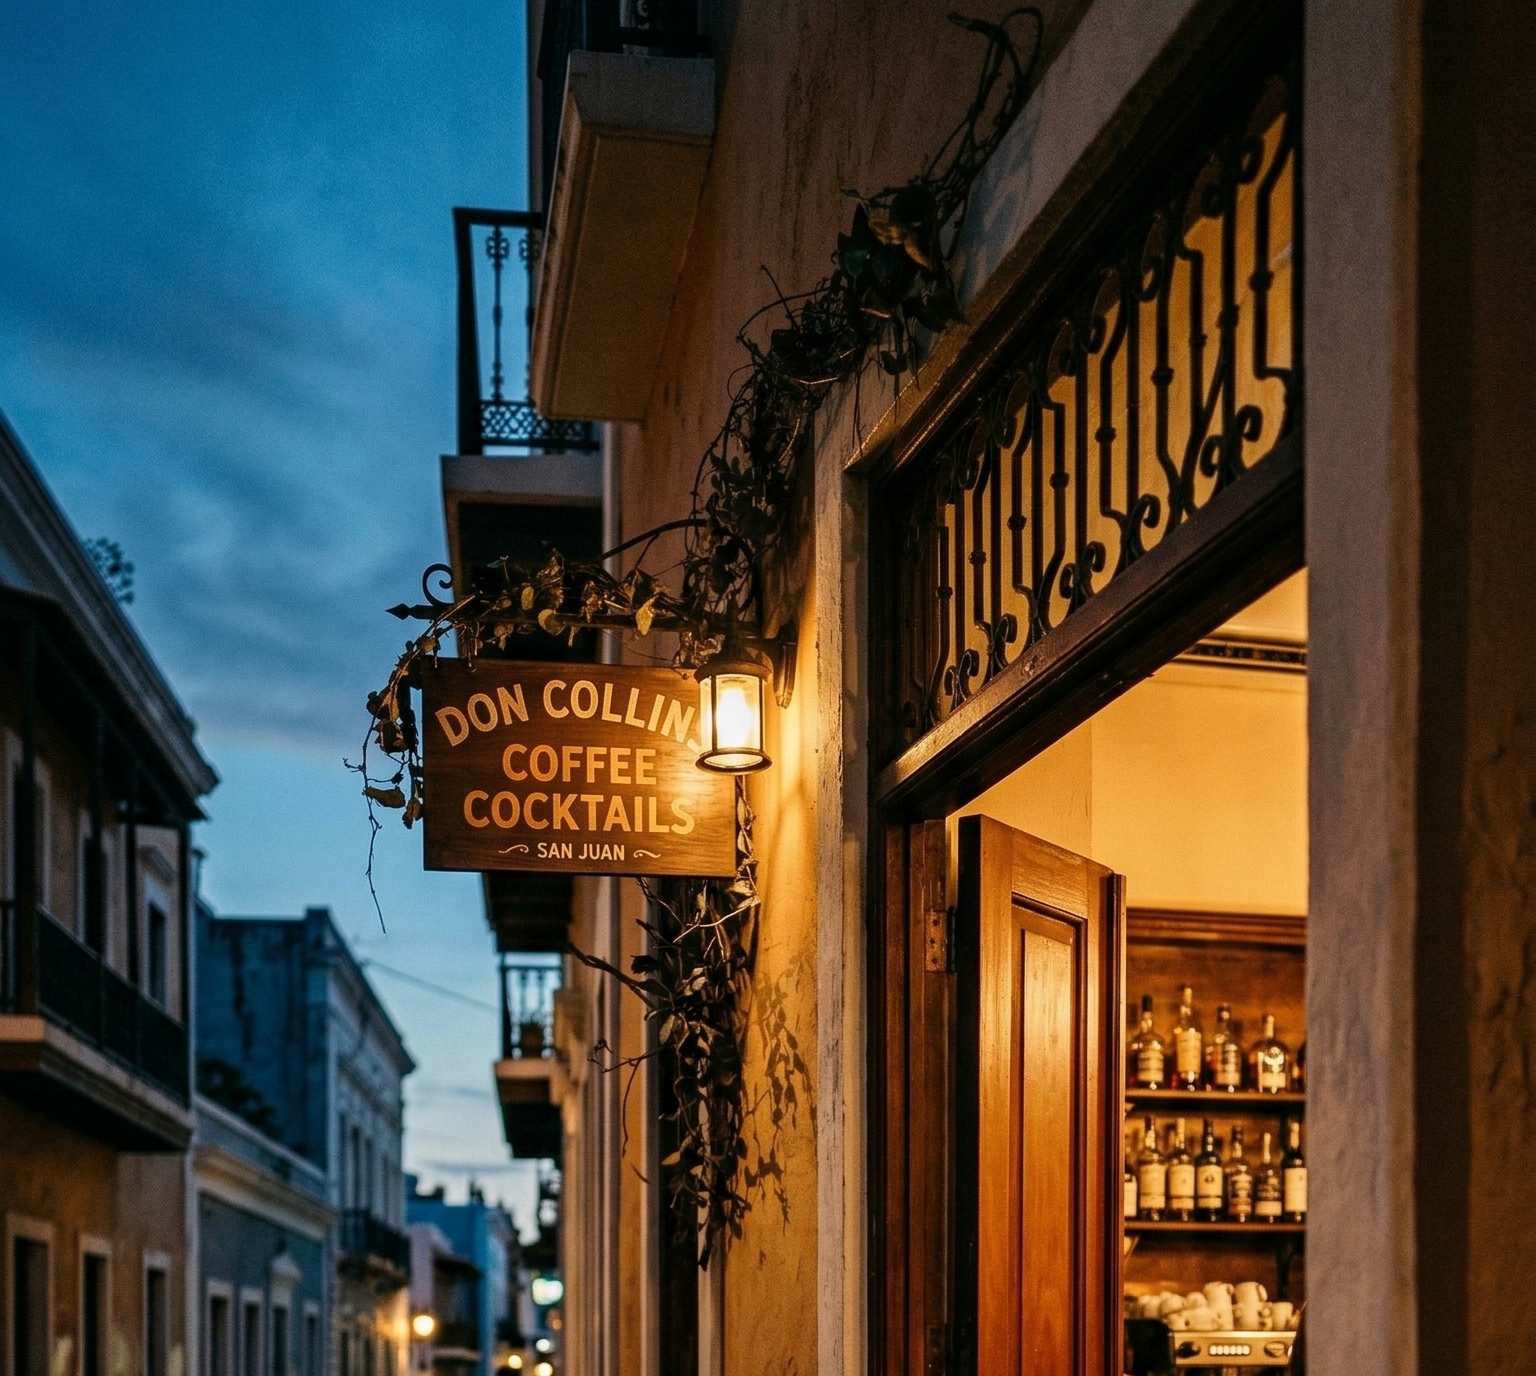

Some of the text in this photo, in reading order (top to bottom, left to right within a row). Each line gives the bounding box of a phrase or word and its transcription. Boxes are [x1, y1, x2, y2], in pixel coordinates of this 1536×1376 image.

[435, 683, 529, 747] DON
[502, 743, 657, 785] COFFEE
[463, 789, 696, 835] COCKTAILS
[537, 842, 625, 861] SAN JUAN
